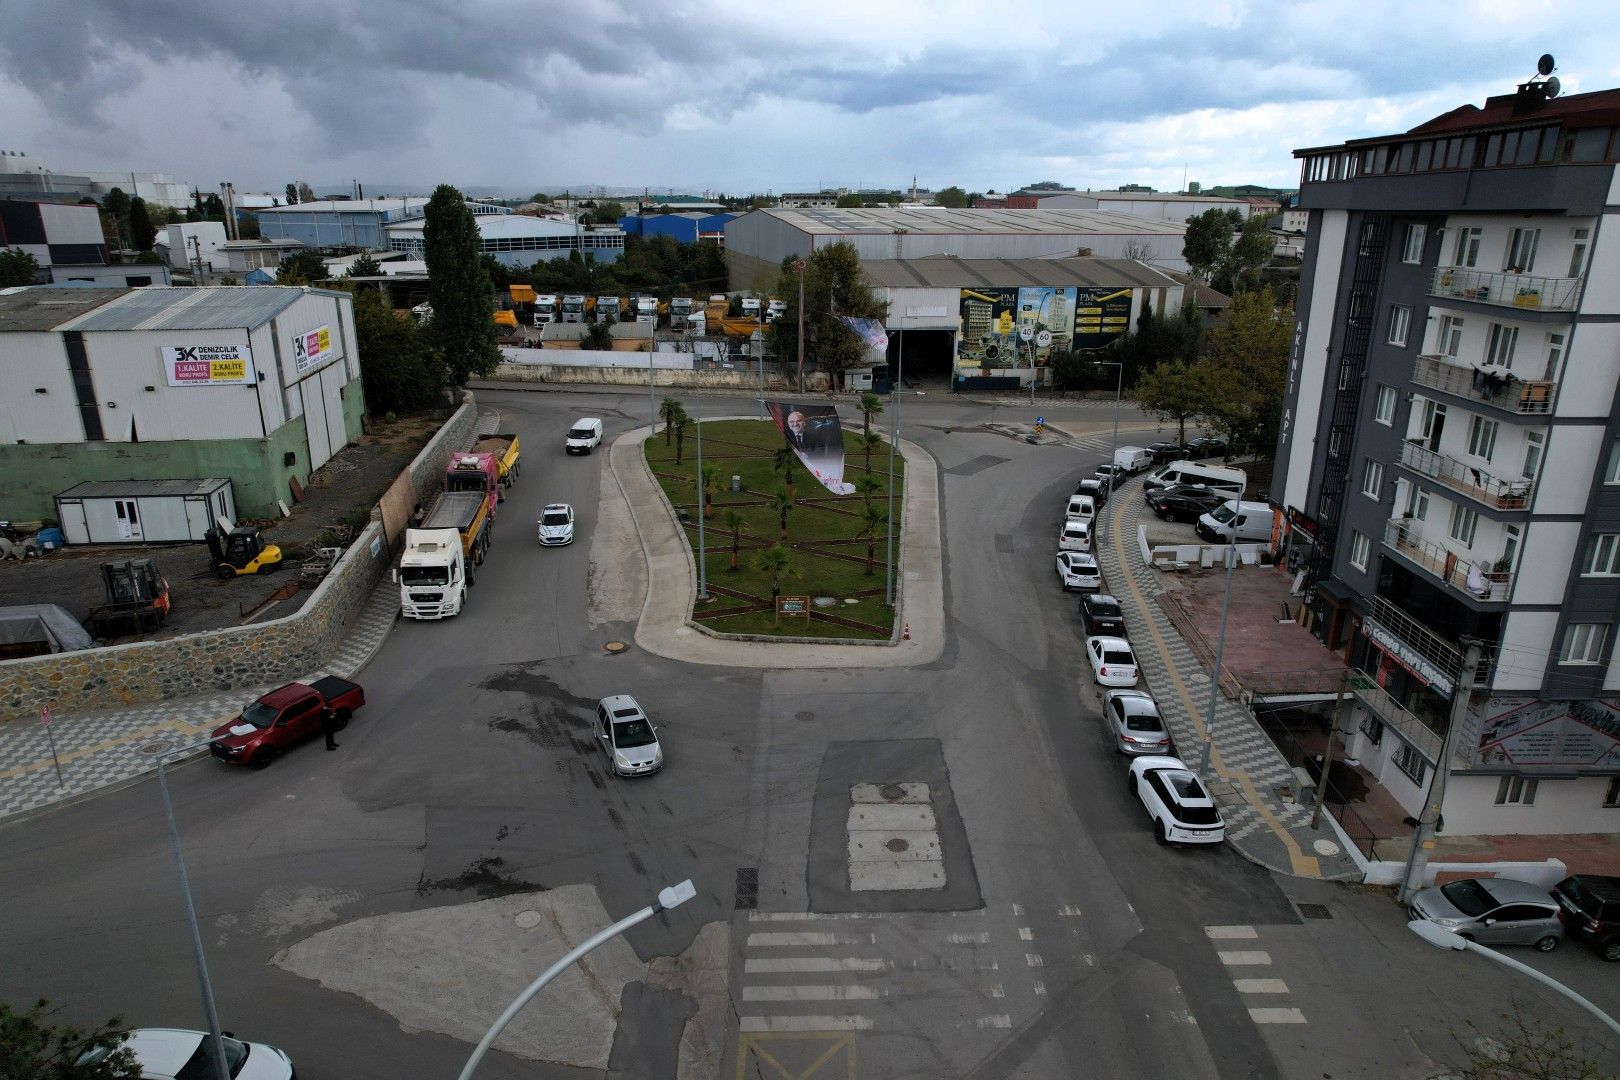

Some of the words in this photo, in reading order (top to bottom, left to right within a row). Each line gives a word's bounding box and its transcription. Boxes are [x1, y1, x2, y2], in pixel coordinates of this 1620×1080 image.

[1001, 293, 1015, 302] PM
[1080, 293, 1095, 302] PM
[1022, 328, 1032, 336] 40
[1039, 333, 1050, 341] 60
[293, 335, 306, 357] 3K
[175, 347, 198, 362] 3K
[1289, 320, 1302, 394] AKINLI
[1282, 408, 1290, 444] APT
